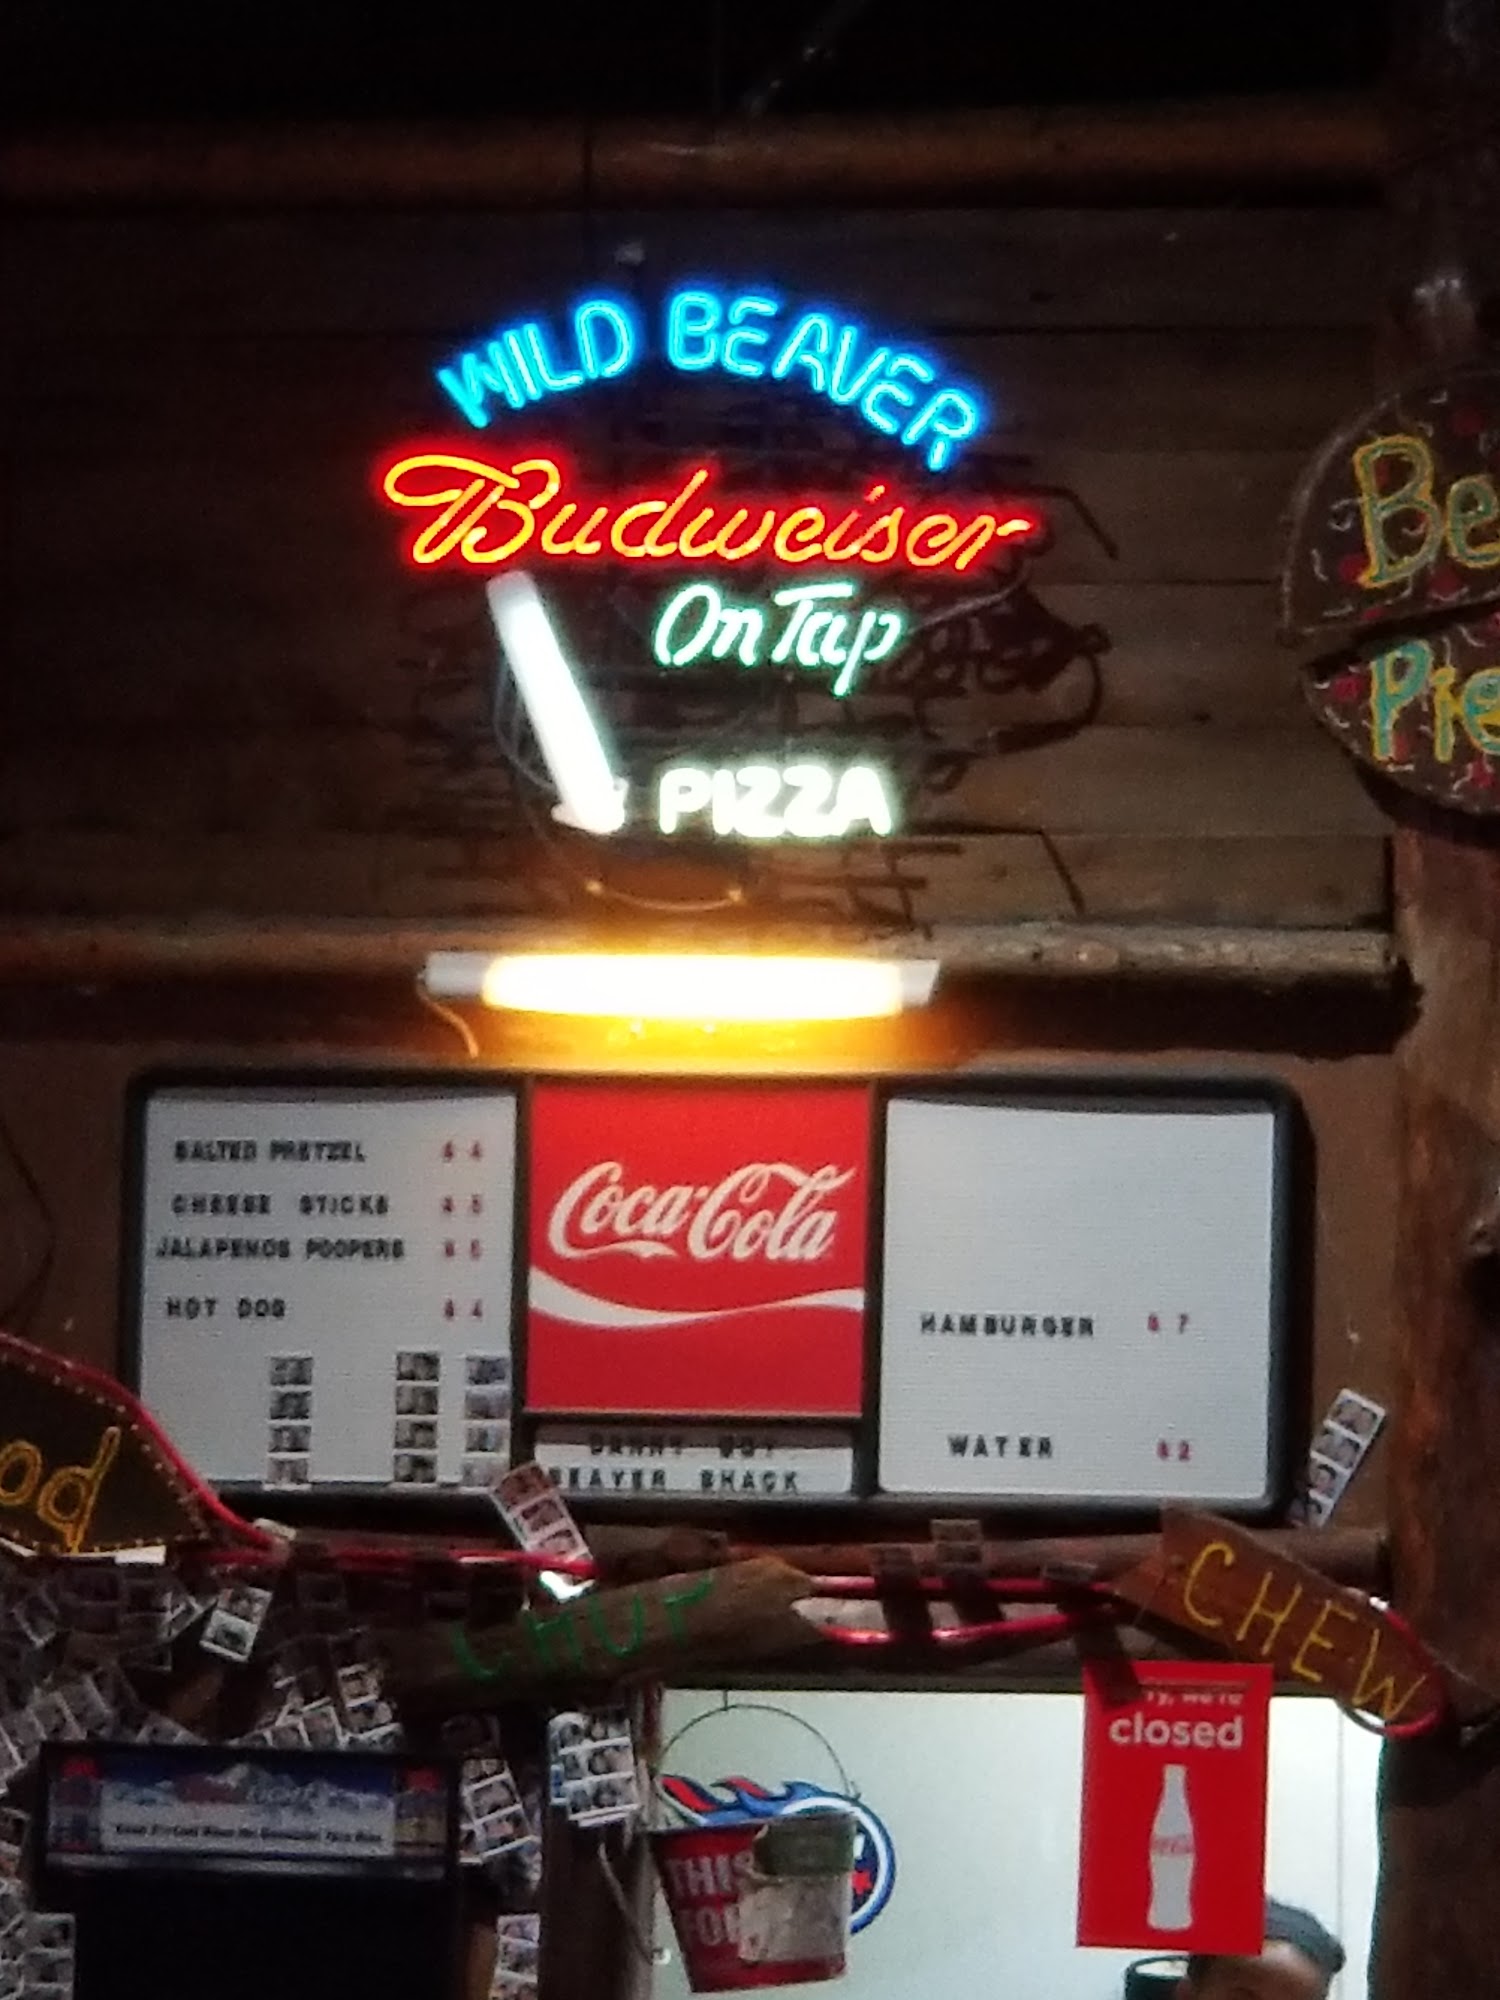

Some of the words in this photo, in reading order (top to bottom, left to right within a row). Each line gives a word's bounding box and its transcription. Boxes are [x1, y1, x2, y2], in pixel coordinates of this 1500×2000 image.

[437, 298, 634, 430] WILD
[667, 290, 979, 470] BEAVER
[383, 454, 1031, 570] Budweiser
[654, 584, 761, 666] On
[772, 580, 902, 696] Tap
[658, 765, 892, 837] PIZZA
[174, 1139, 257, 1162] SALTED
[269, 1139, 367, 1162] PRETZEL
[170, 1194, 271, 1215] CHEESE
[300, 1194, 389, 1215] STICKS
[547, 1161, 856, 1262] Coca-Cola
[155, 1237, 290, 1259] JALAPENOS
[166, 1296, 216, 1319] HOT
[237, 1297, 286, 1319] DOG
[920, 1313, 1094, 1337] HAMBURGER
[948, 1434, 1053, 1459] WATER
[699, 1468, 799, 1492] SHACK
[1183, 1541, 1427, 1721] CHEW
[1108, 1711, 1244, 1751] closed
